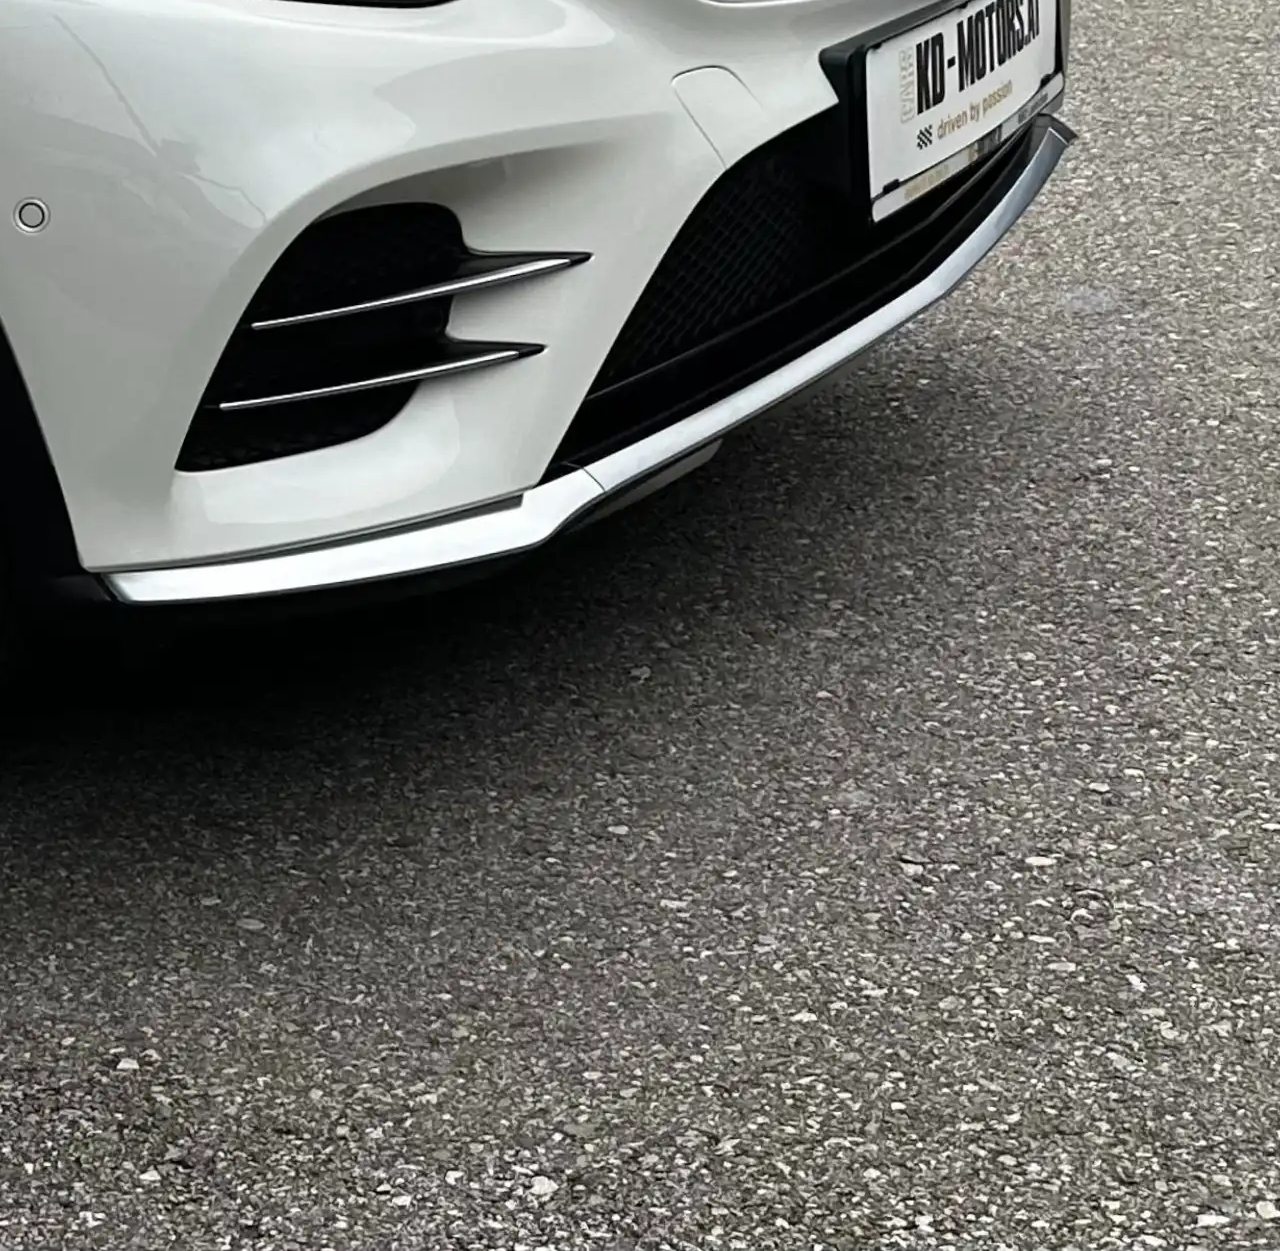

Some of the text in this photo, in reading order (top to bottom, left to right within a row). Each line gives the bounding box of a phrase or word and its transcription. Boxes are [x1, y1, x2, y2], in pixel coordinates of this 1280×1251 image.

[936, 110, 969, 140] driven
[969, 100, 981, 124] by
[982, 78, 1014, 119] passion
